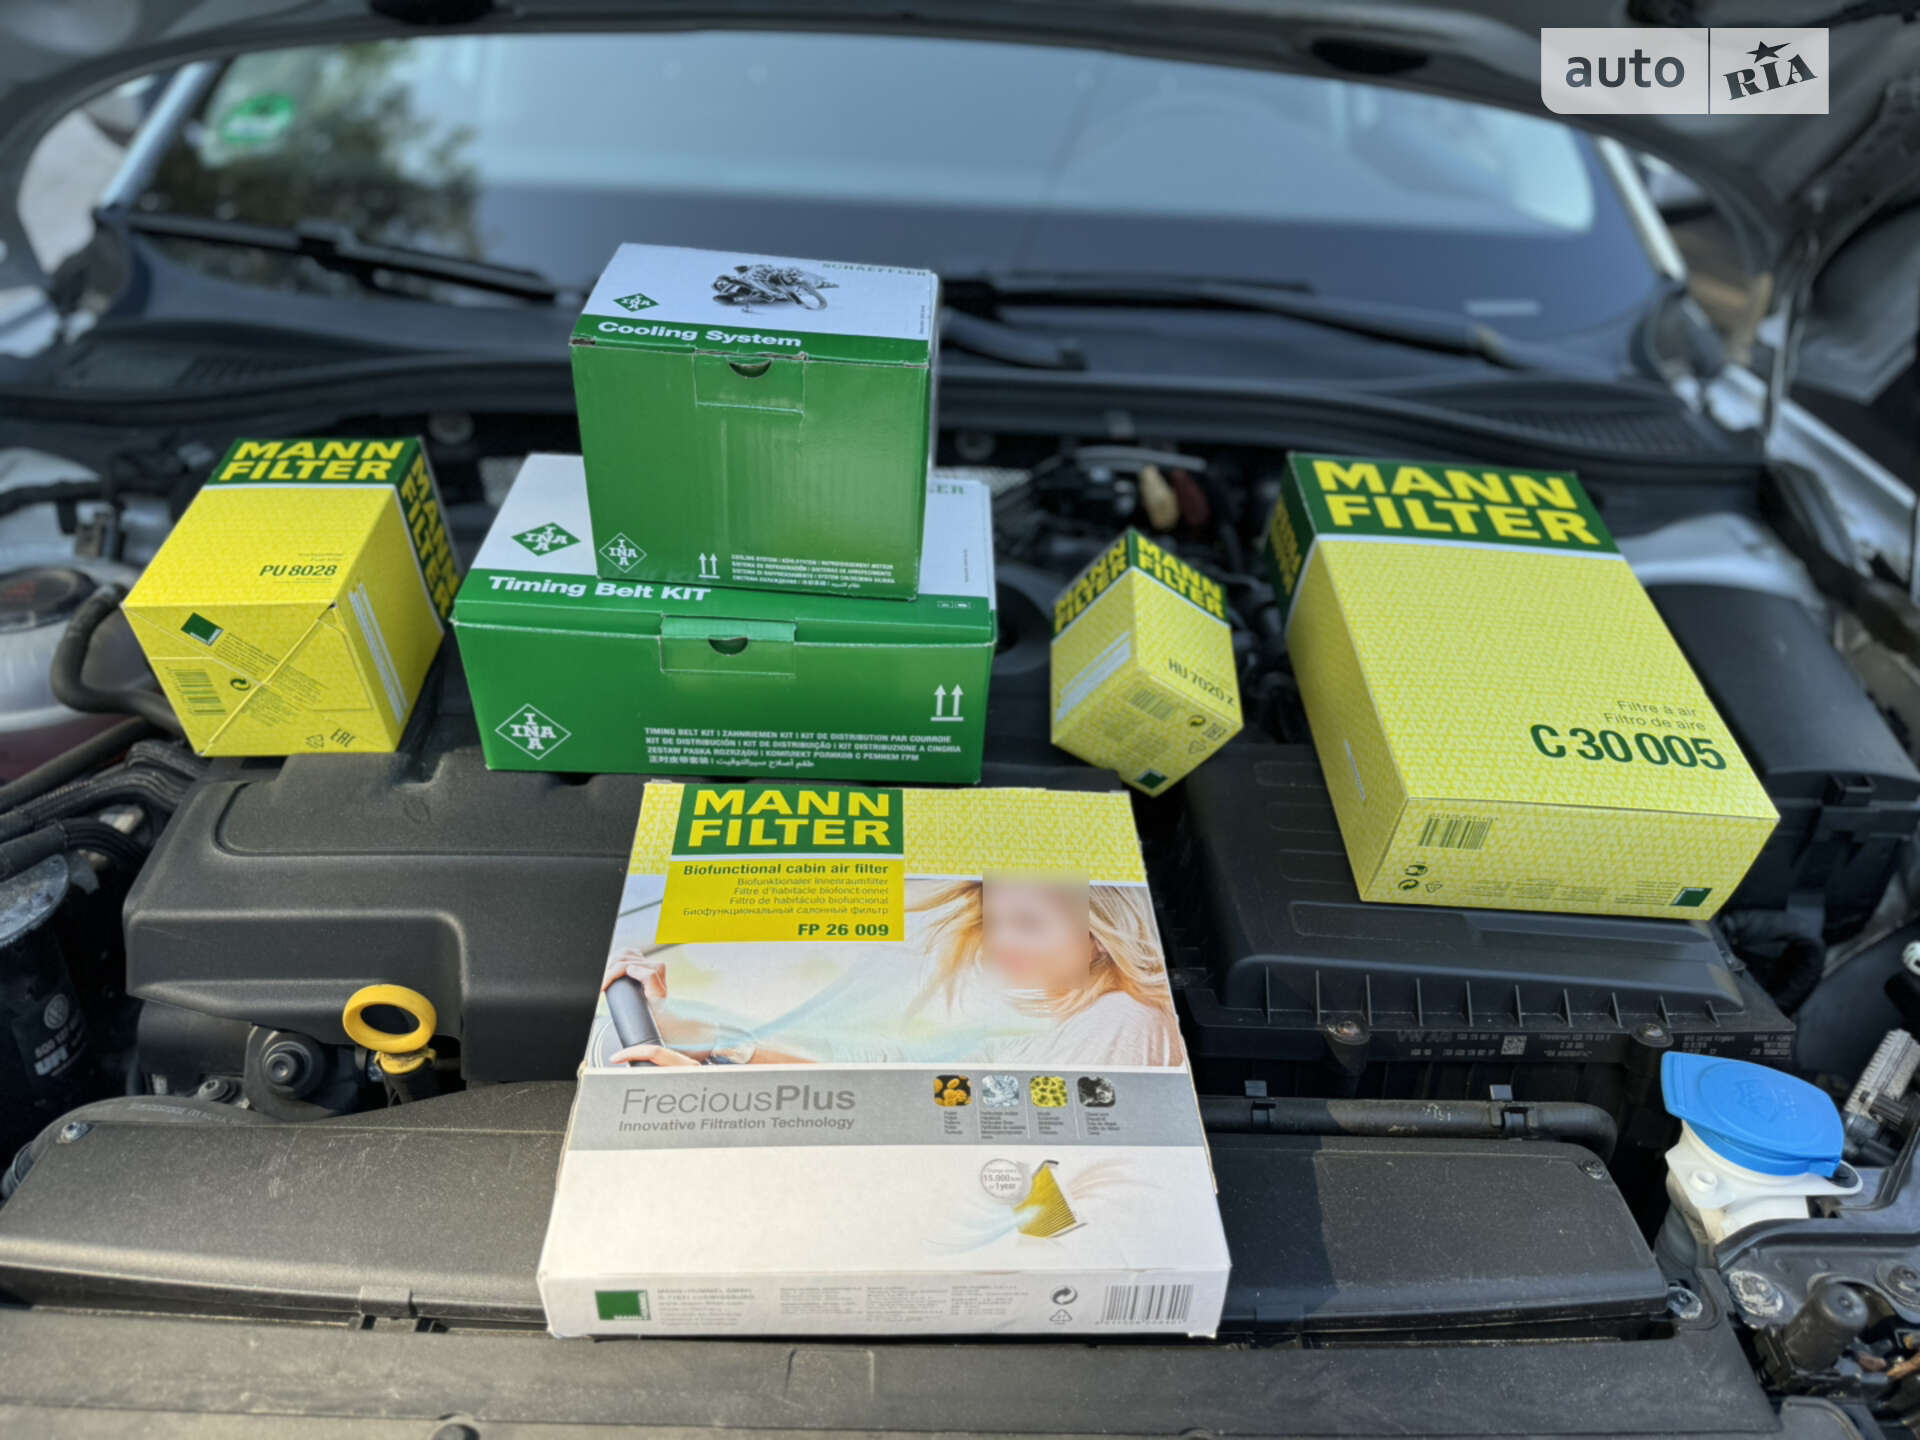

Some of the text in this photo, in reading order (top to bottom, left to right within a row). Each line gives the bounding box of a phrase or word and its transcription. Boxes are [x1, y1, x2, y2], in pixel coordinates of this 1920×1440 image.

[597, 321, 802, 347] Cooling System
[233, 441, 405, 460] MANN
[218, 459, 392, 481] FILTER
[1312, 460, 1578, 510] MANN
[1324, 494, 1600, 545] FILTER
[259, 564, 338, 577] PU 8028
[1137, 534, 1224, 600] MANN
[488, 575, 712, 601] Timing Belt KIT
[1138, 552, 1225, 620] FILTER
[1616, 699, 1660, 715] Filtre
[1677, 706, 1697, 718] air
[1603, 711, 1707, 731] Filtro de aire
[645, 728, 676, 736] TIMING
[678, 728, 698, 736] BELT
[701, 729, 714, 737] KIT
[780, 731, 793, 739] KIT
[830, 733, 888, 741] DISTRIBUTION
[693, 789, 890, 817] MANN
[687, 819, 891, 848] FILTER
[684, 863, 889, 876] Biofunctional cabin air filter
[729, 896, 757, 905] Filtro
[759, 896, 771, 904] de
[733, 887, 760, 895] Filtre
[797, 923, 889, 936] FP 26 009
[621, 1085, 856, 1115] FreciousPlus
[618, 1116, 855, 1132] Innovative Filtration Technology
